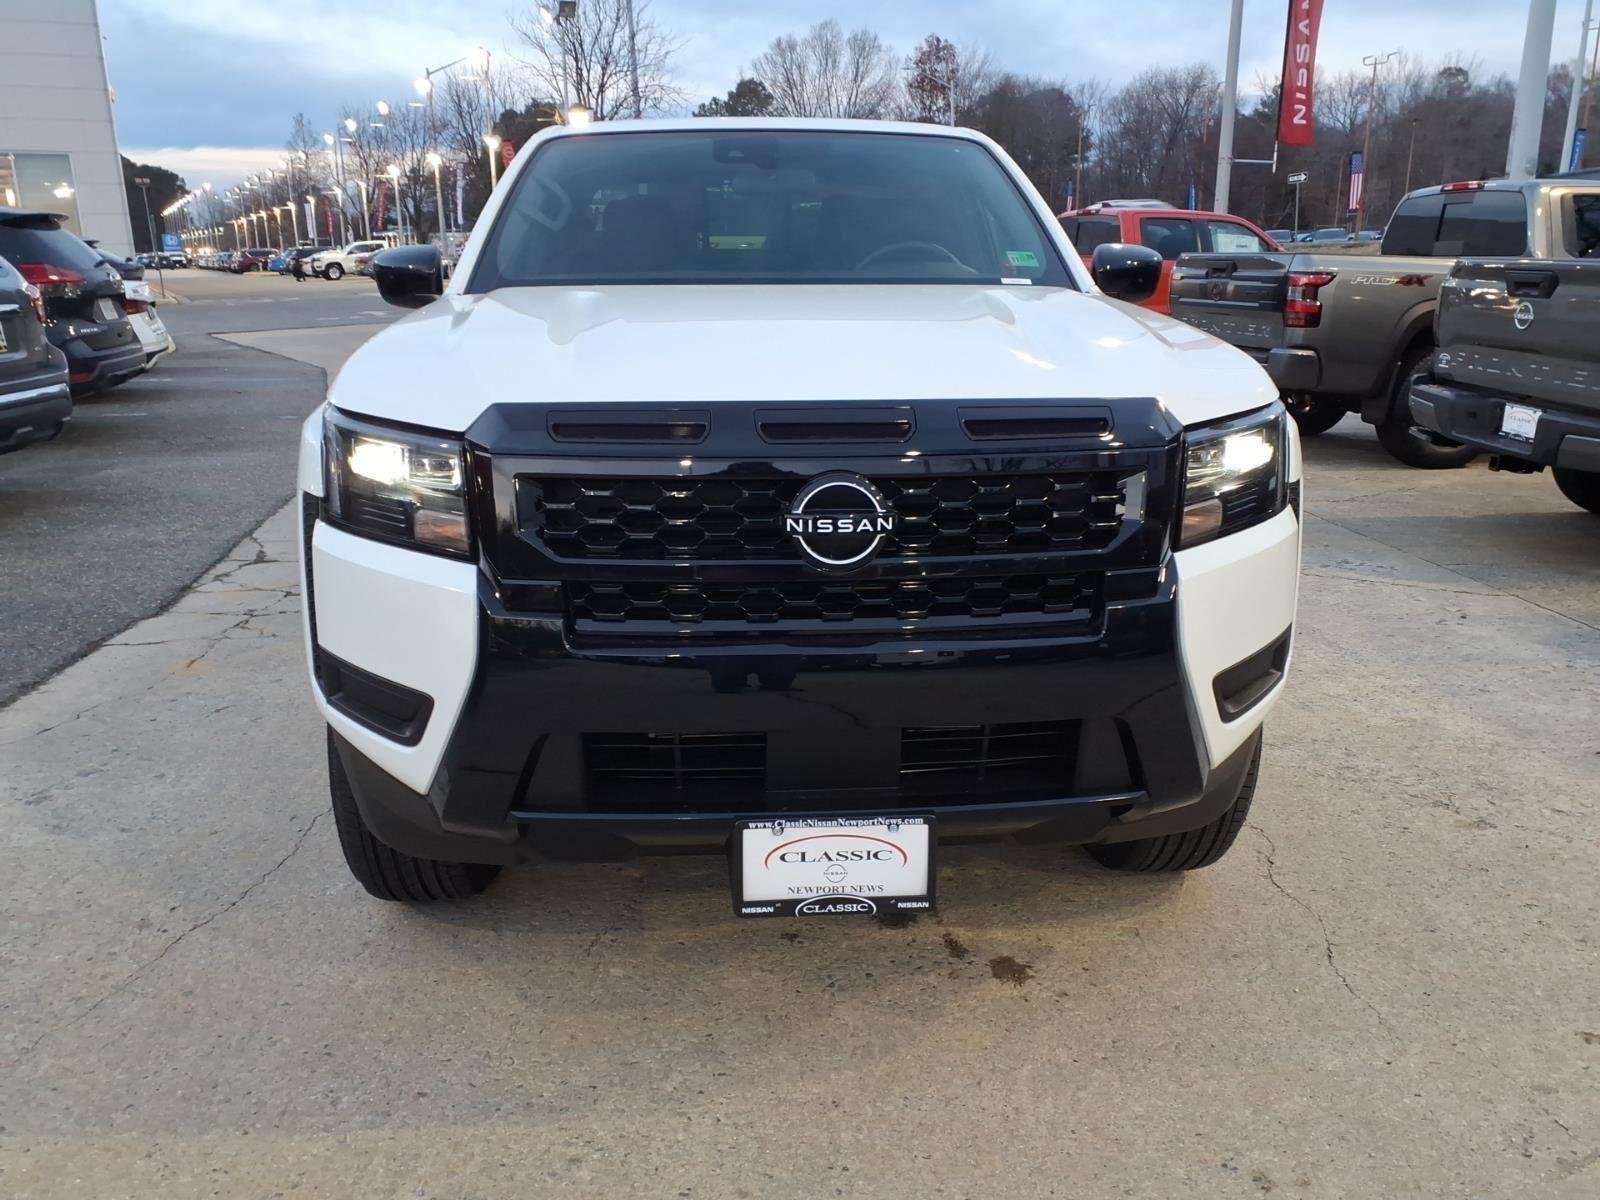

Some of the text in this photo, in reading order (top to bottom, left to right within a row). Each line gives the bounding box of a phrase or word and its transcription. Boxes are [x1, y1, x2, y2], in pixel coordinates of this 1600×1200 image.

[786, 517, 894, 533] NISSAN
[748, 817, 924, 830] www.ClassicNissanNewportNews.com
[779, 850, 892, 864] CLASSIC
[787, 884, 884, 895] NEWPORT NEWS
[741, 906, 774, 914] NISSAN
[803, 903, 869, 913] CLASSIC
[897, 901, 929, 909] NISSAN
